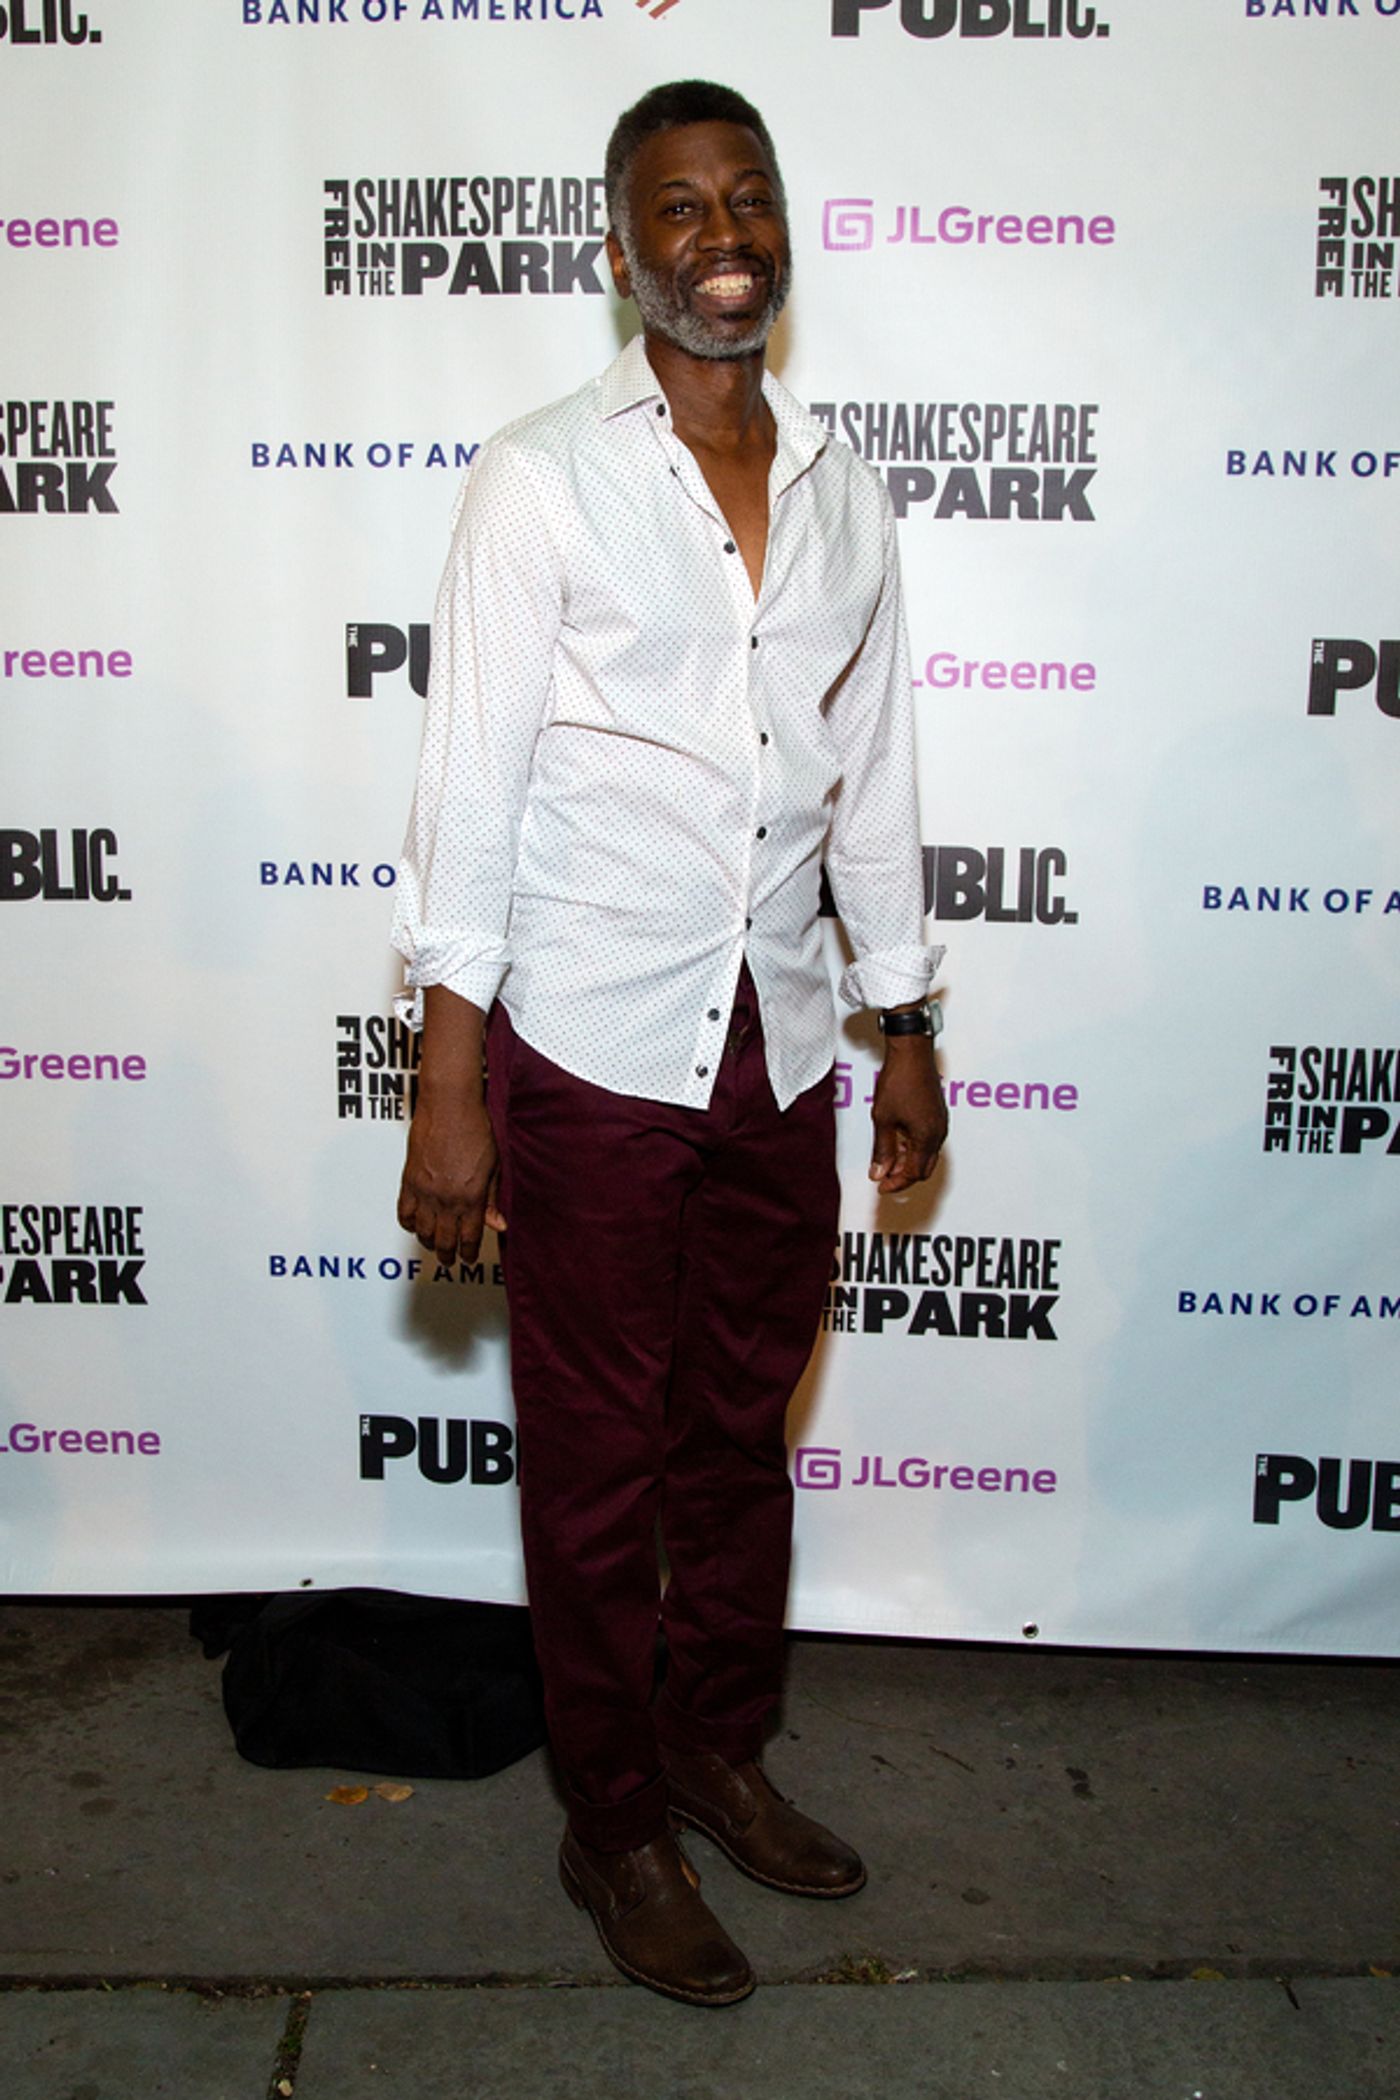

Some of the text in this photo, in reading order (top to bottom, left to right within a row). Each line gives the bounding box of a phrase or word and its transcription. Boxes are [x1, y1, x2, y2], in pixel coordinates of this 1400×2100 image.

[0, 0, 101, 45] LIC.
[243, 0, 603, 24] BANK OF AMERICA
[1246, 0, 1359, 17] BANK
[355, 176, 604, 238] SHAKESPEARE
[0, 219, 118, 247] eene
[324, 180, 350, 295] FREE
[889, 207, 1115, 245] JLGreene
[1316, 177, 1348, 297] FREE
[358, 243, 395, 268] IN
[402, 238, 606, 295] PARK
[1352, 243, 1394, 269] IN
[357, 270, 395, 295] THE
[1351, 271, 1392, 298] THE
[0, 401, 115, 457] PEARE
[841, 402, 1099, 463] SHAKESPEARE
[252, 443, 353, 467] BANK
[367, 443, 413, 467] OF
[1227, 451, 1400, 477] BANK OF
[911, 653, 1096, 691] Greene
[261, 862, 359, 886] BANK
[1204, 886, 1309, 912] BANK
[1324, 889, 1372, 913] OF
[337, 1016, 362, 1118] FREE
[369, 1073, 405, 1096] IN
[1264, 1046, 1296, 1152] FREE
[368, 1096, 406, 1121] THE
[1298, 1105, 1338, 1129] IN
[1297, 1129, 1335, 1153] THE
[0, 1204, 144, 1257] ESPEARE
[0, 1259, 147, 1304] ARK
[270, 1256, 365, 1279] BANK
[379, 1257, 423, 1281] OF
[863, 1285, 1059, 1340] PARK
[1179, 1292, 1280, 1315] BANK
[1294, 1295, 1340, 1316] OF
[0, 1423, 160, 1455] Greene
[359, 1415, 521, 1486] PUB
[852, 1456, 1056, 1493] JLGreene
